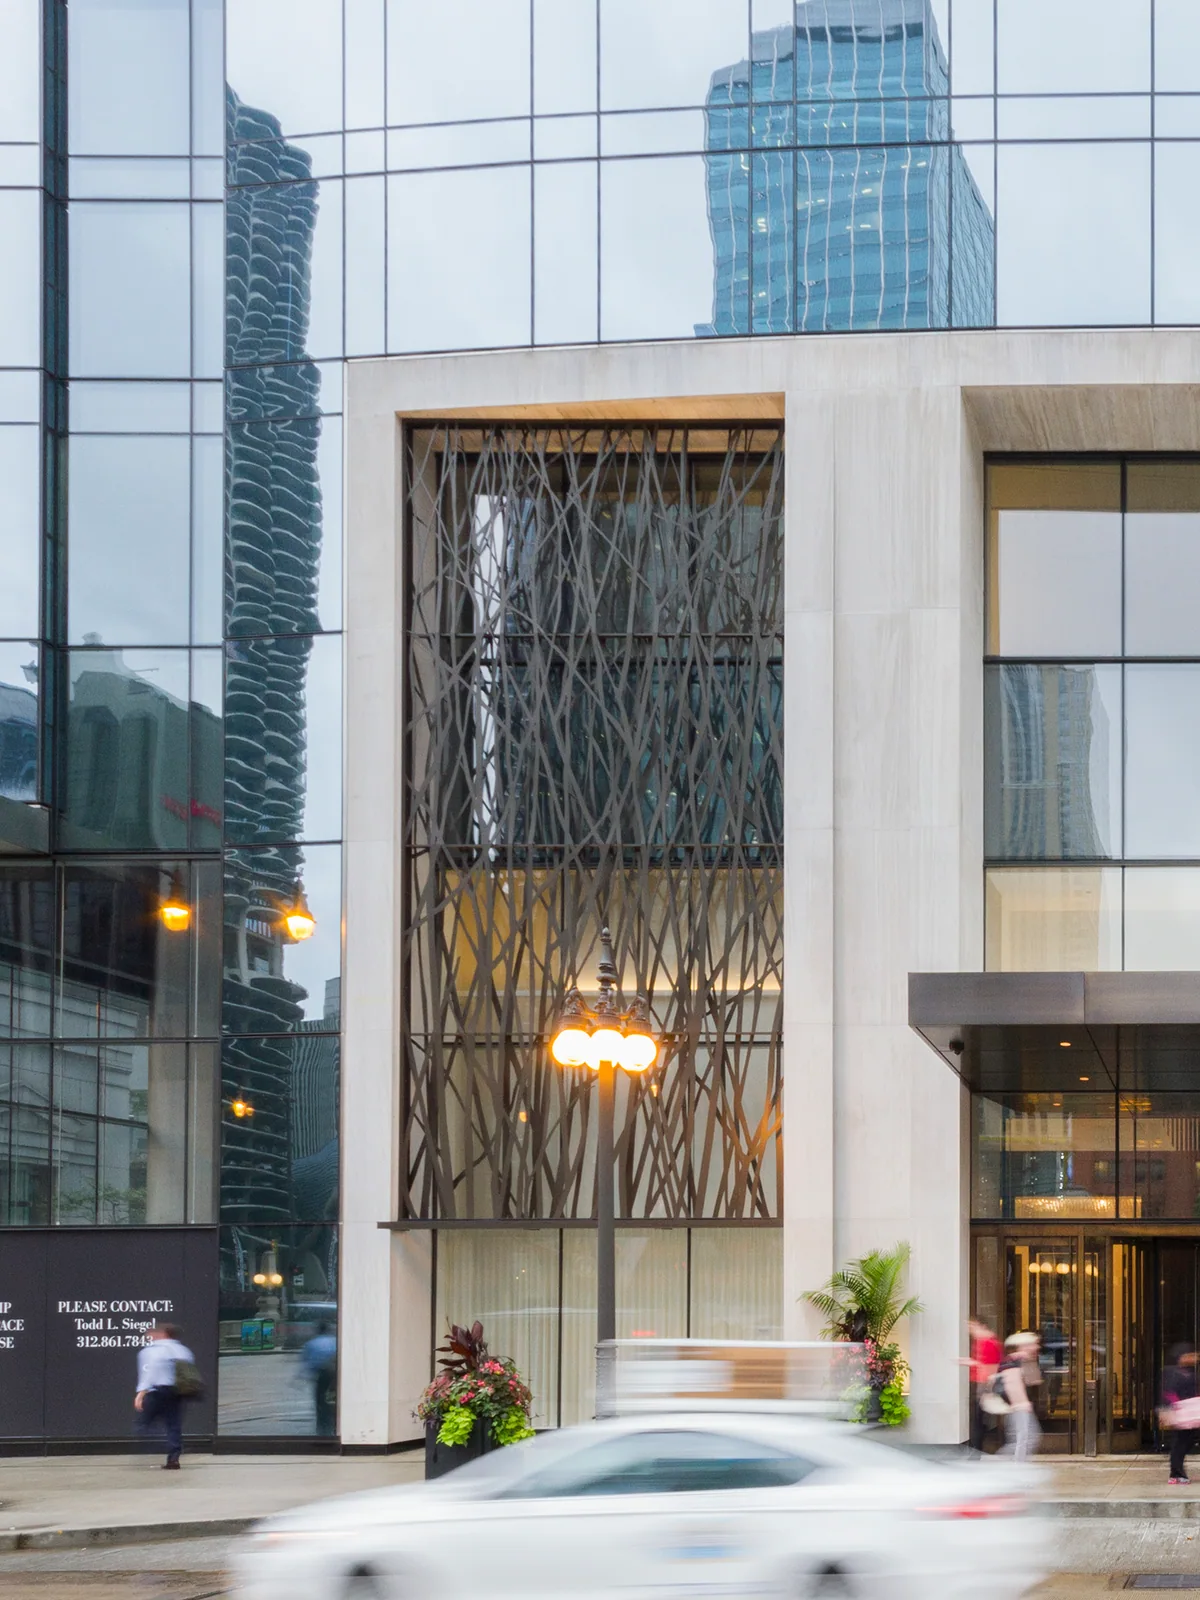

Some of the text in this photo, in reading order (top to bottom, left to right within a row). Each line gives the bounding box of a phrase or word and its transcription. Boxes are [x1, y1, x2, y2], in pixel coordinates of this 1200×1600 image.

[58, 1300, 174, 1313] PLEASE CONTACT:
[75, 1318, 156, 1333] Todd L. Siegel
[76, 1335, 154, 1348] 312.861.7843
